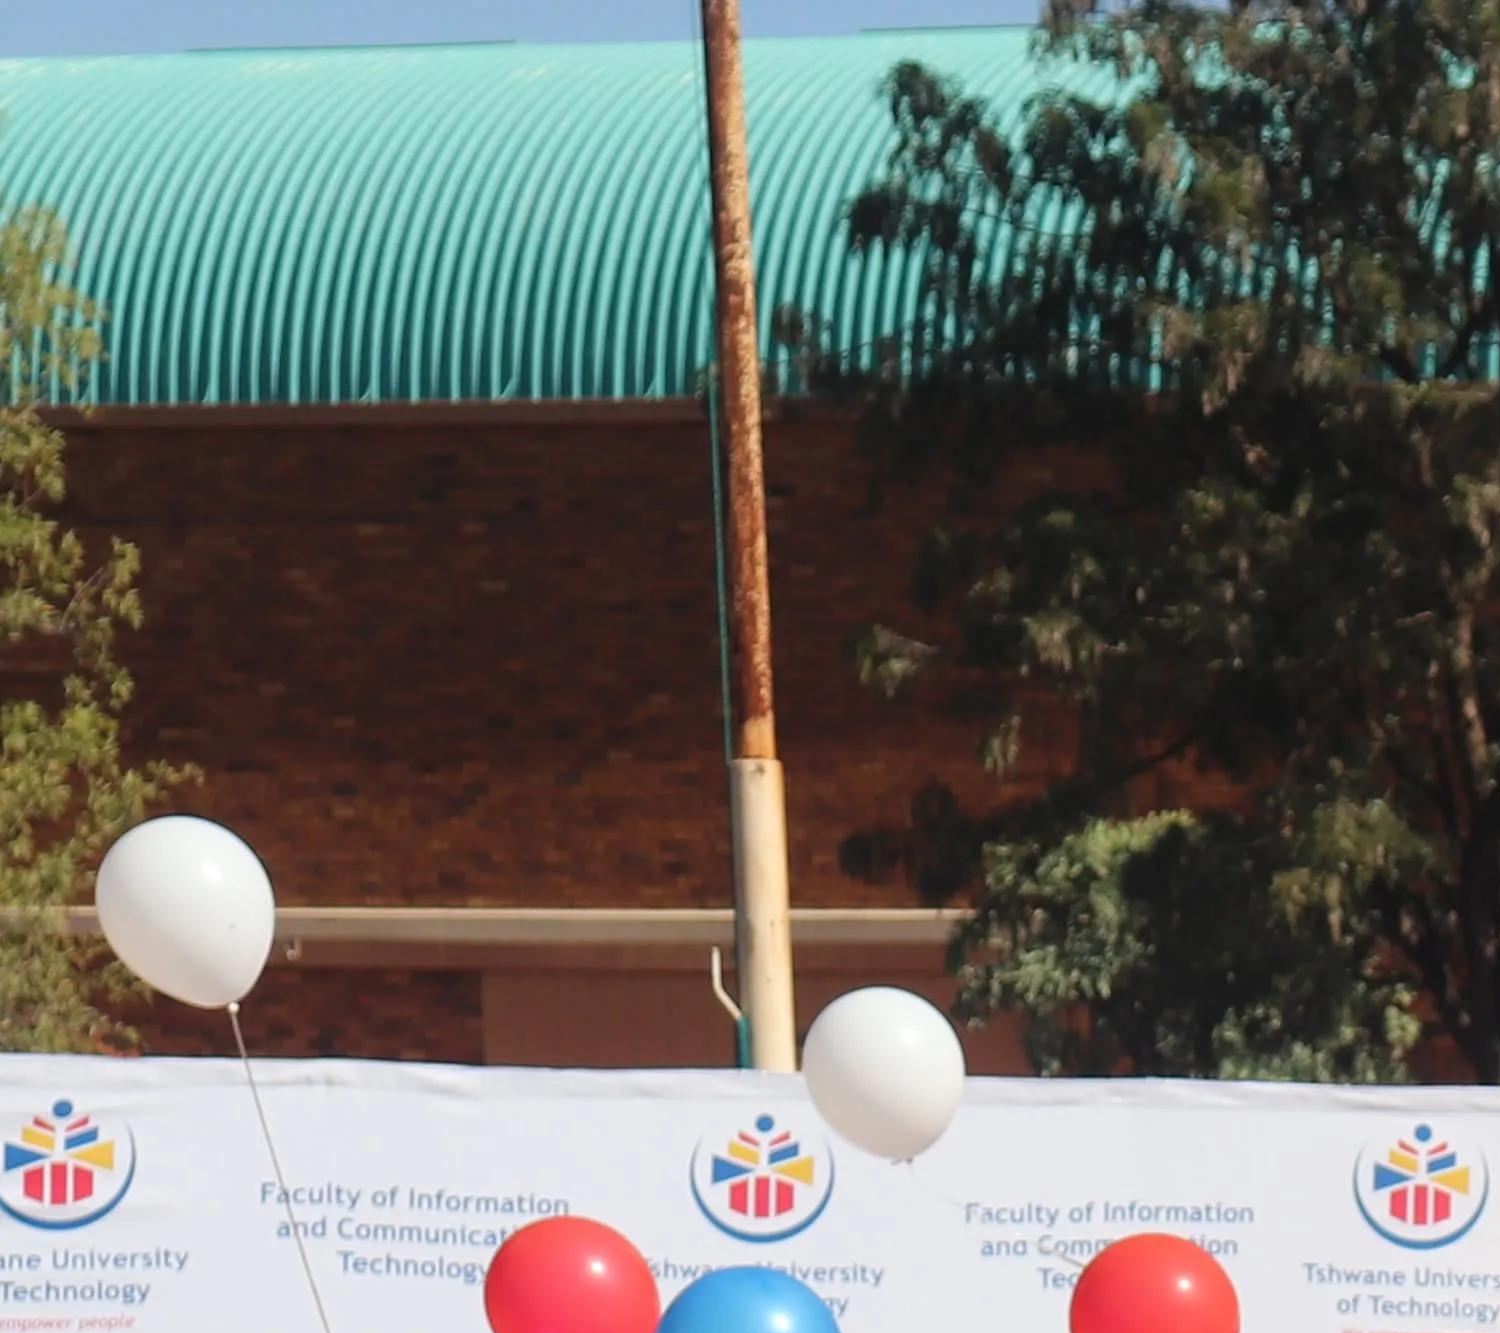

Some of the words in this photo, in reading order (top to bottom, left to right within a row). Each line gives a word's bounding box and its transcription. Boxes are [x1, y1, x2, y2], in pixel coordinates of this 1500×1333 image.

[261, 1182, 360, 1210] Faculty
[371, 1186, 398, 1208] of
[409, 1187, 569, 1217] Information
[965, 1201, 1059, 1228] Faculty
[1069, 1201, 1094, 1223] of
[1104, 1200, 1254, 1223] Information
[277, 1217, 326, 1239] and
[337, 1218, 514, 1247] Communicat
[52, 1248, 189, 1271] University
[1303, 1262, 1406, 1285] Tshwane
[1, 1280, 152, 1304] Technology
[1337, 1294, 1360, 1314] of
[1368, 1295, 1499, 1323] Technology
[78, 1313, 135, 1332] people
